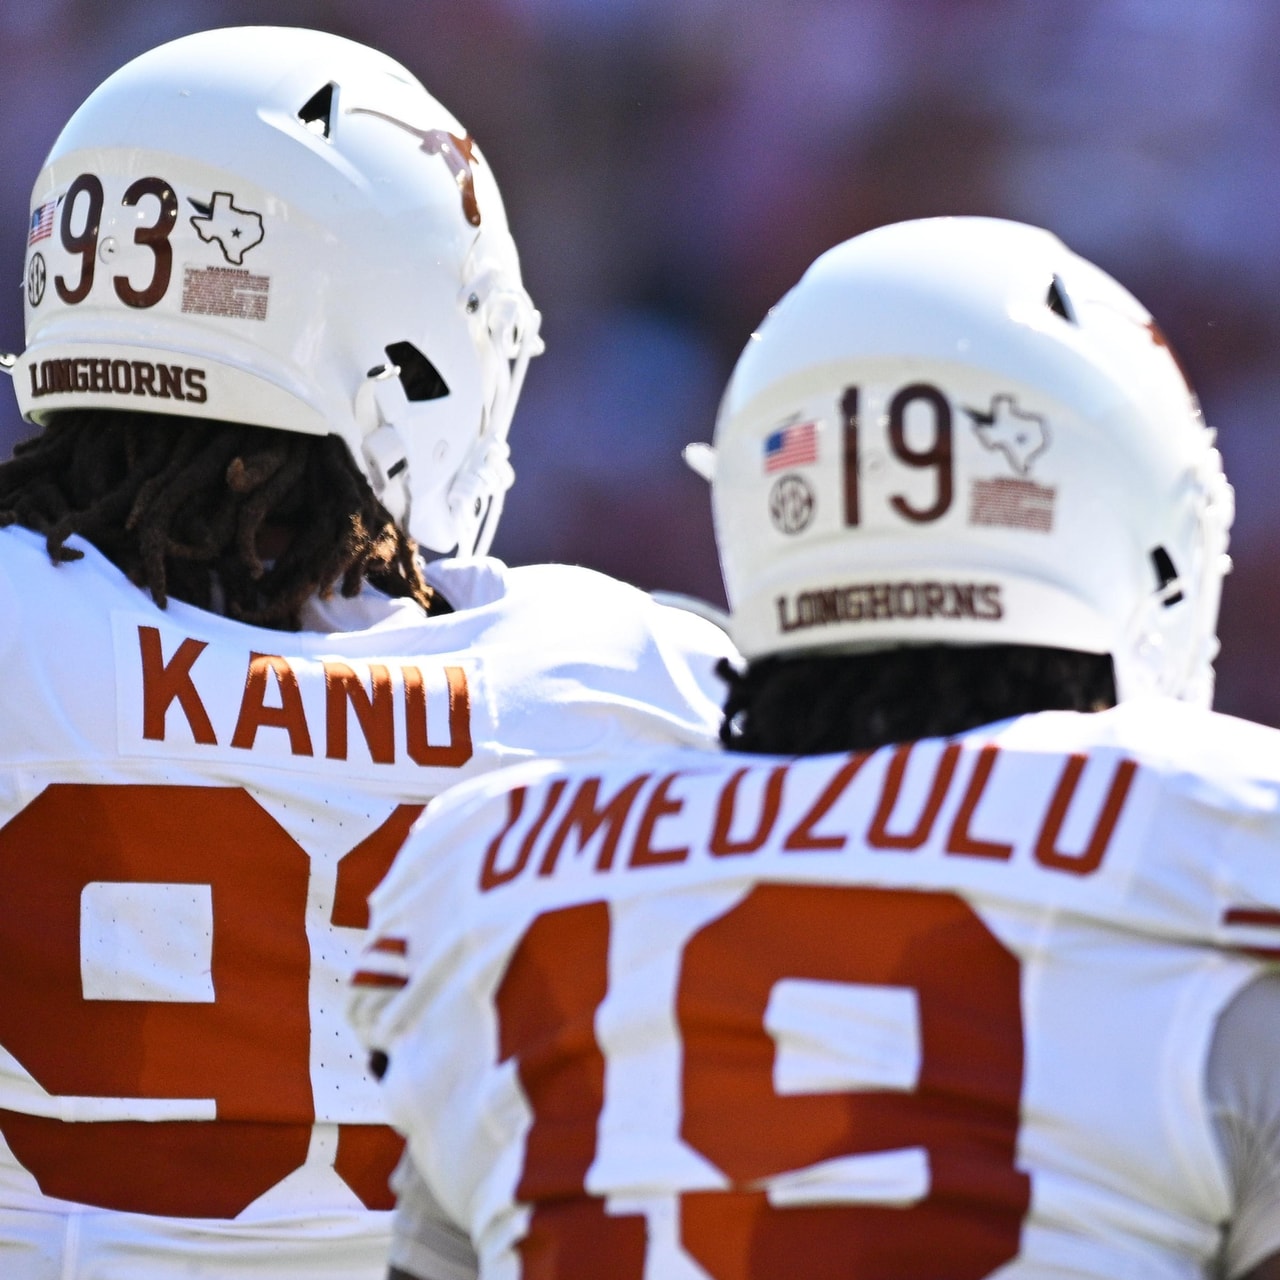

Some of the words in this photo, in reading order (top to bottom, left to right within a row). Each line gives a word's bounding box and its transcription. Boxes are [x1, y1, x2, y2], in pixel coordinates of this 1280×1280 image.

[54, 172, 179, 309] 93
[28, 358, 208, 404] LONGHORNS
[838, 382, 954, 528] 19
[776, 581, 1005, 634] LONGHORNS
[137, 625, 473, 768] KANU
[477, 742, 1139, 894] UMEOZULU
[0, 782, 414, 1221] 9
